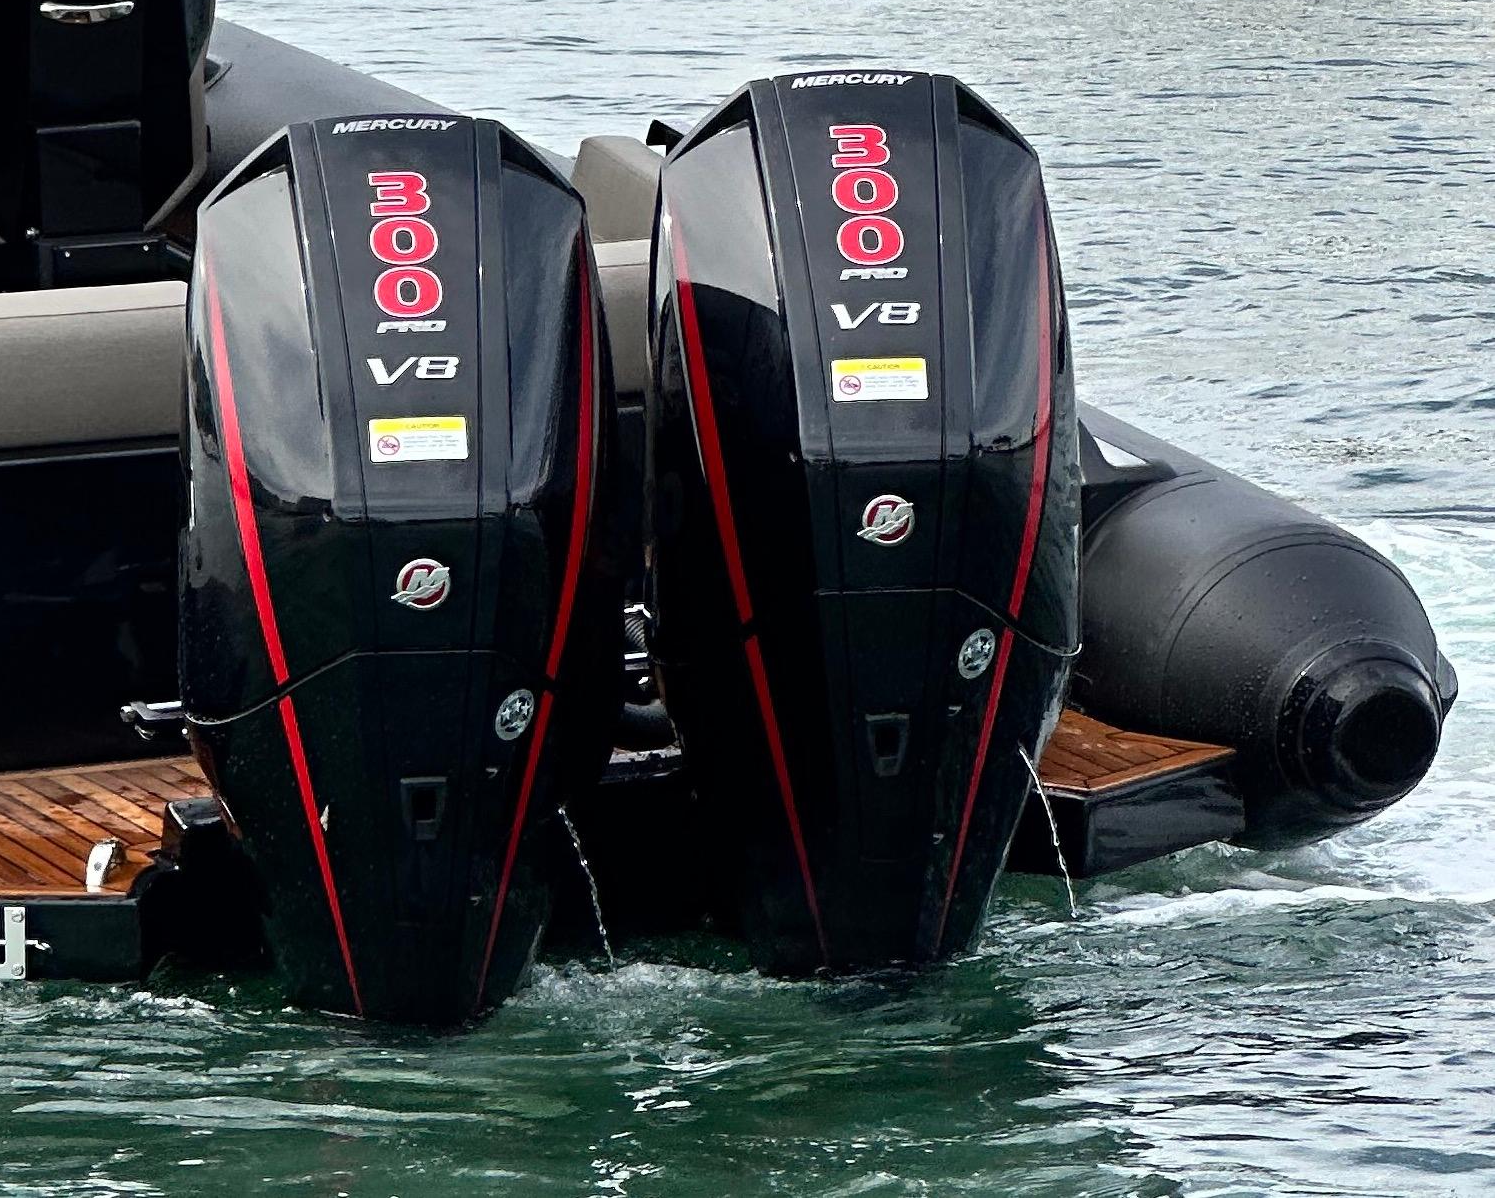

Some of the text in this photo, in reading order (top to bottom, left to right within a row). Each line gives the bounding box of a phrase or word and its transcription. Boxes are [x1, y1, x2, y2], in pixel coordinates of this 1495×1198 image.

[791, 73, 913, 89] MERCURY
[332, 119, 457, 135] MERCURY
[829, 123, 905, 266] 300
[367, 171, 444, 318] 300
[839, 267, 909, 281] PRO
[376, 320, 447, 334] PRO
[830, 302, 922, 330] V8
[366, 355, 461, 385] V8
